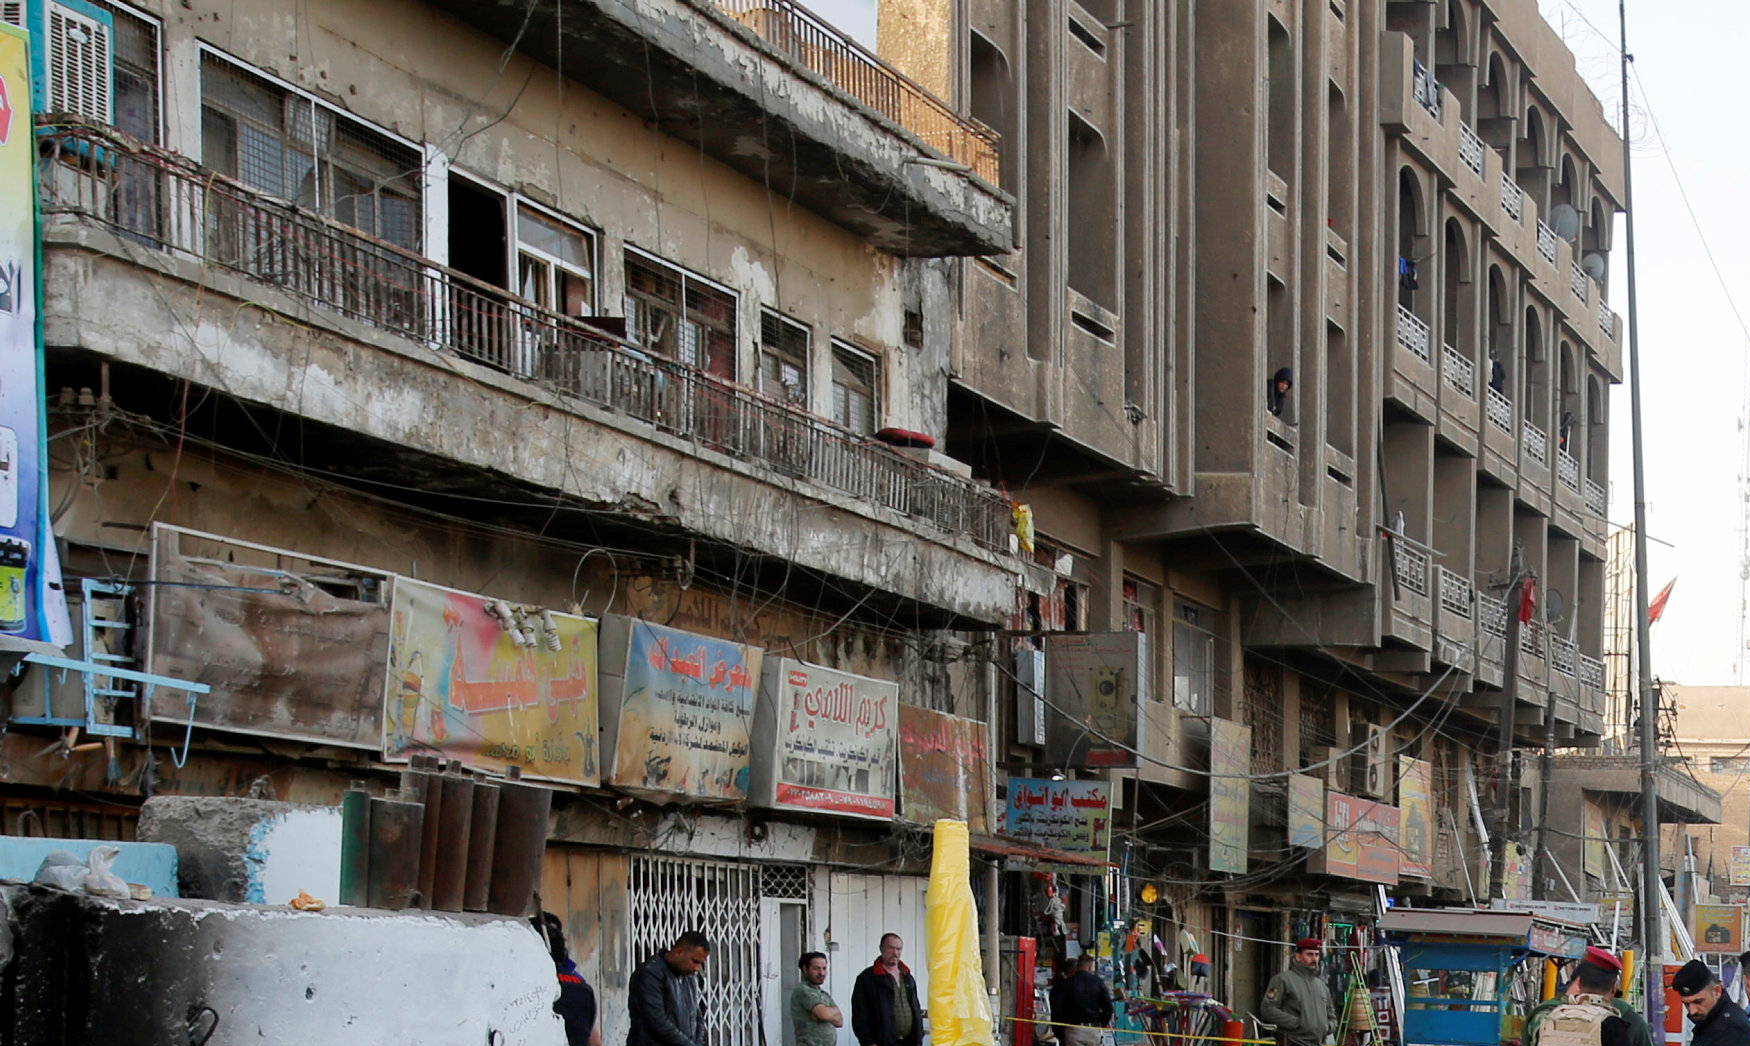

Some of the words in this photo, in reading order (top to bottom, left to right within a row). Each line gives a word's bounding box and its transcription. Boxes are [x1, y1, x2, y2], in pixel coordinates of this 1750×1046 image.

[670, 646, 706, 685] العبد
[708, 649, 753, 692] معرض
[804, 682, 855, 729] اللامي
[855, 695, 888, 740] كريم
[1050, 786, 1069, 812] ابو
[1070, 787, 1107, 812] مكتب
